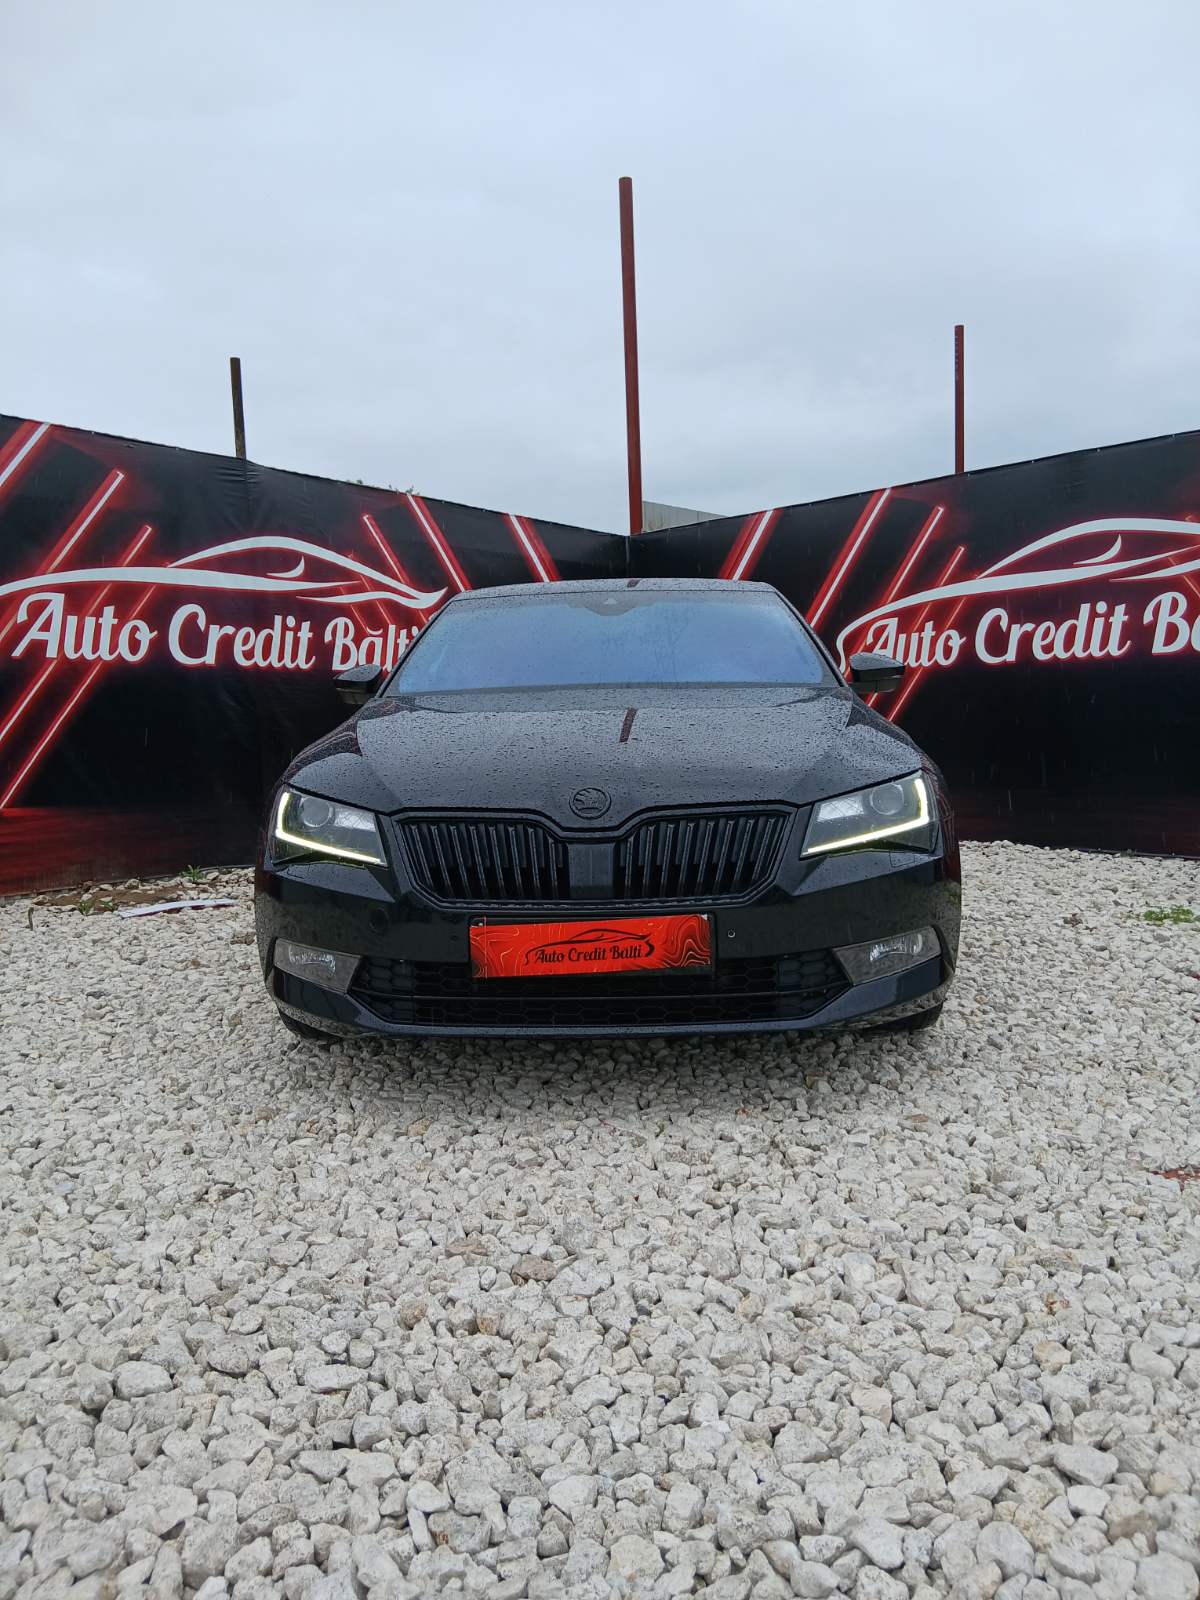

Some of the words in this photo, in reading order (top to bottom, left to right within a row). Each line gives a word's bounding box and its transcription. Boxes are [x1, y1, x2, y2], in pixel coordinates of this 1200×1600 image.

[11, 593, 158, 661] Auto
[168, 603, 316, 669] Credit
[324, 616, 419, 672] Bălt
[866, 617, 967, 667] Auto
[974, 600, 1131, 664] Credit
[535, 949, 564, 963] Auto
[568, 948, 606, 961] Credit
